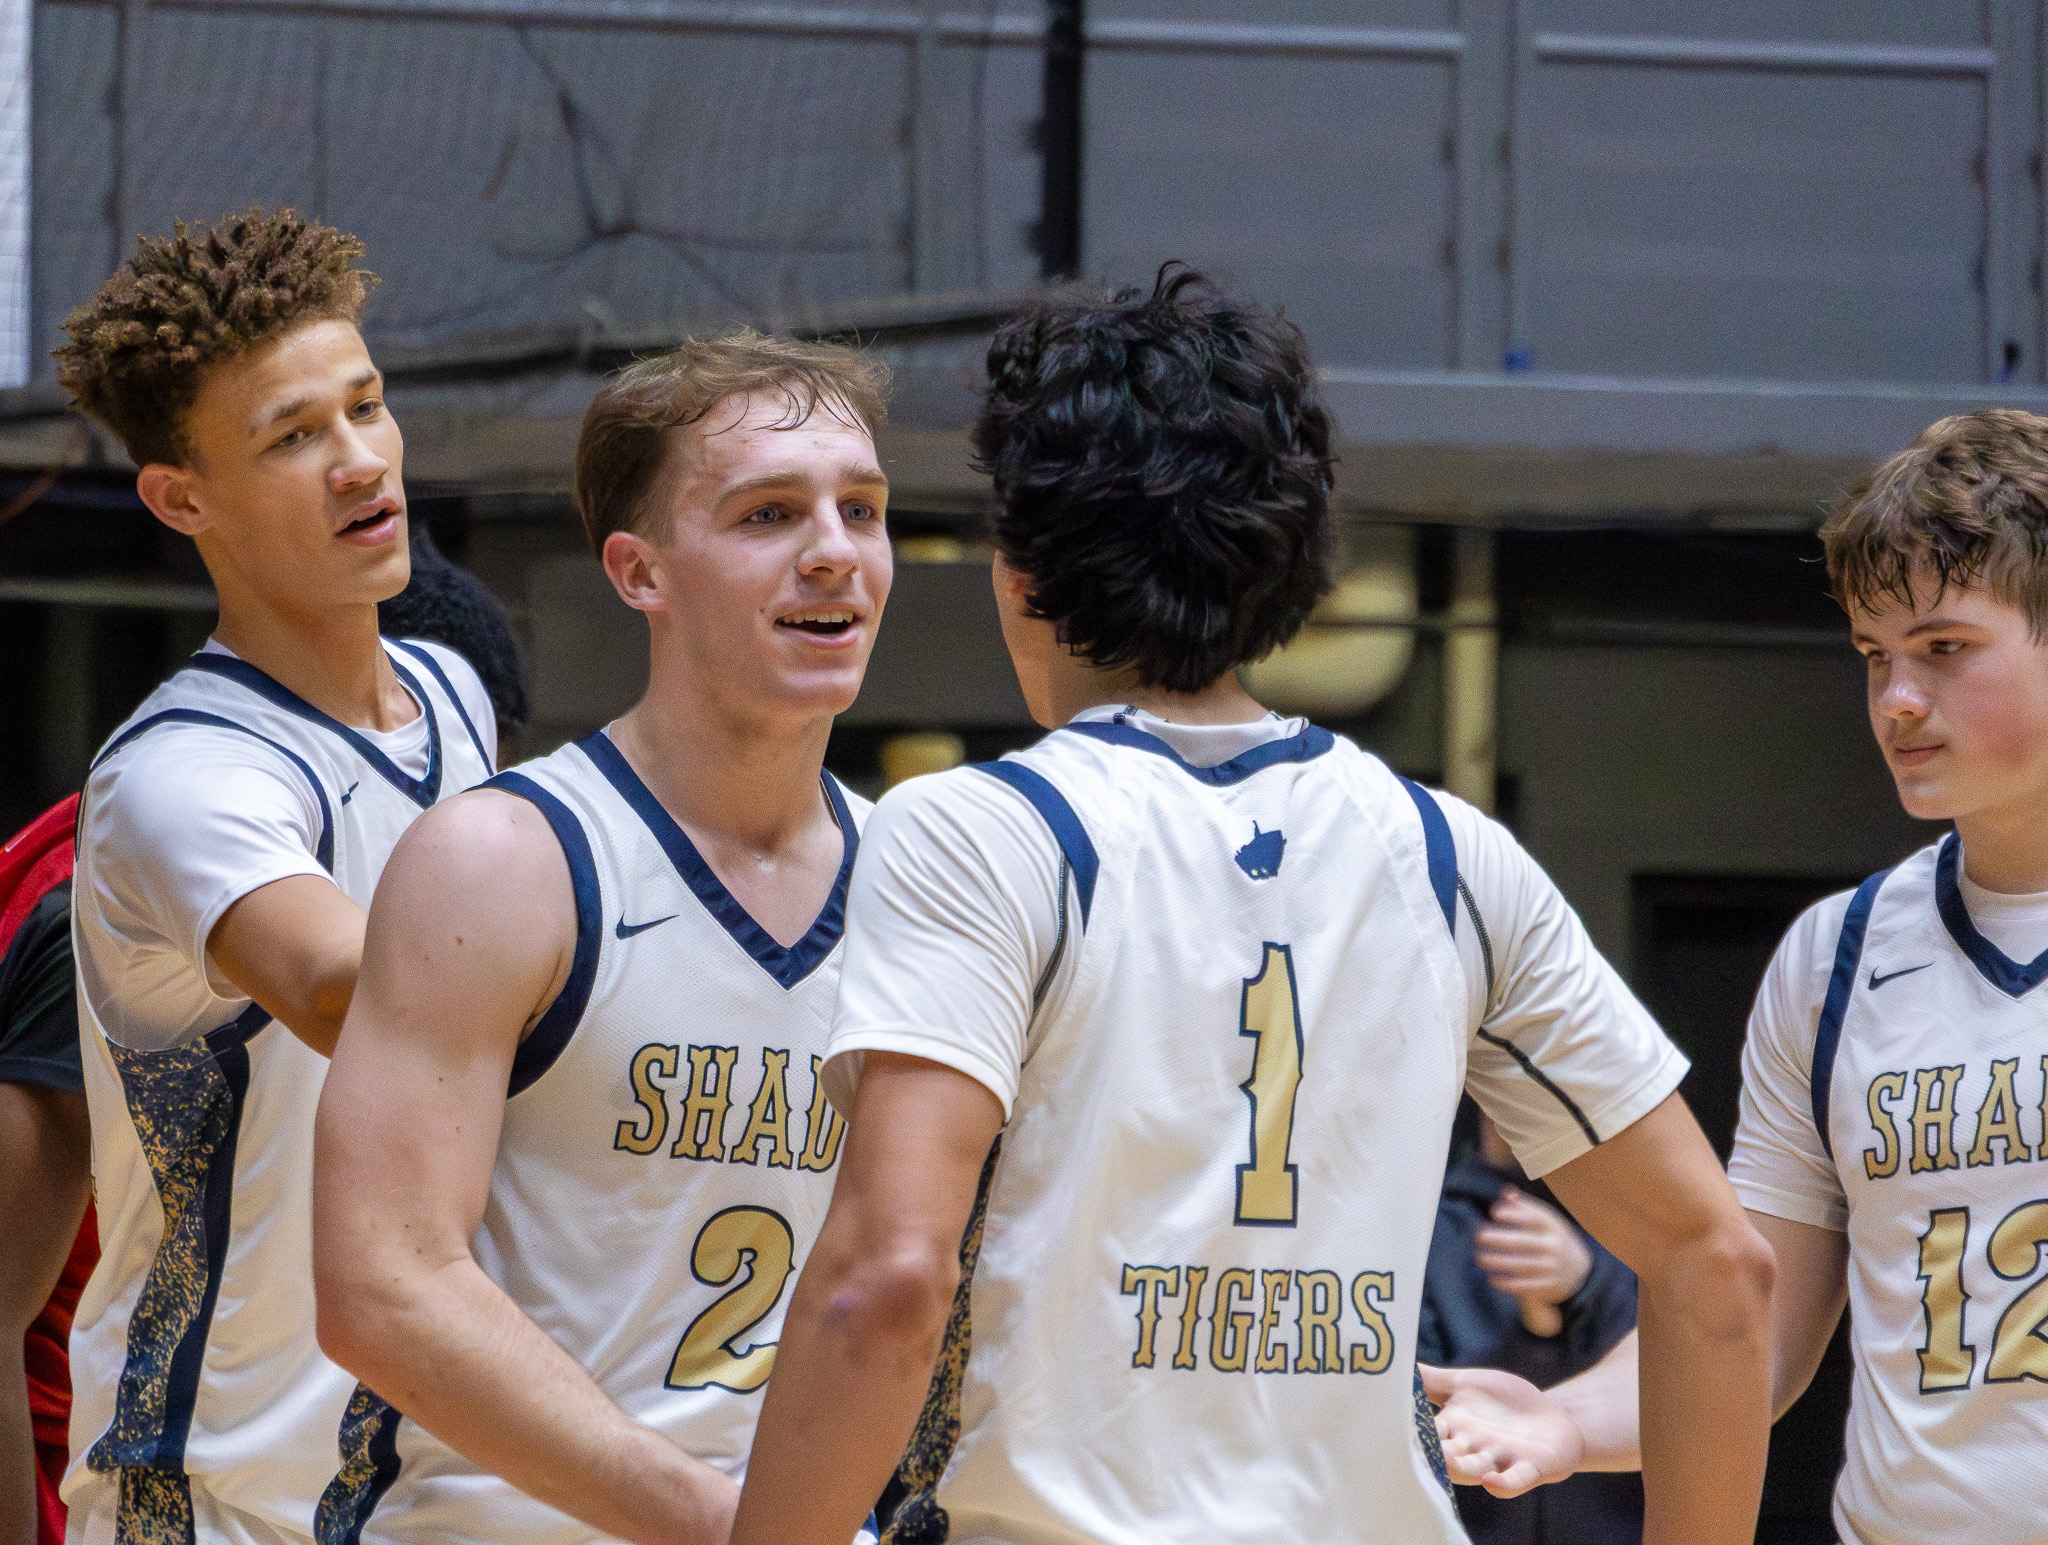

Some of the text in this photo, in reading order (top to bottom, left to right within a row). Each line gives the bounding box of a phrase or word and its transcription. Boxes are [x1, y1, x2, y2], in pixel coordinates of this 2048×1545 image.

[1233, 941, 1304, 1228] 1
[1863, 1055, 2048, 1181] SHA
[664, 1205, 796, 1395] 2
[1121, 1263, 1395, 1376] TIGERS
